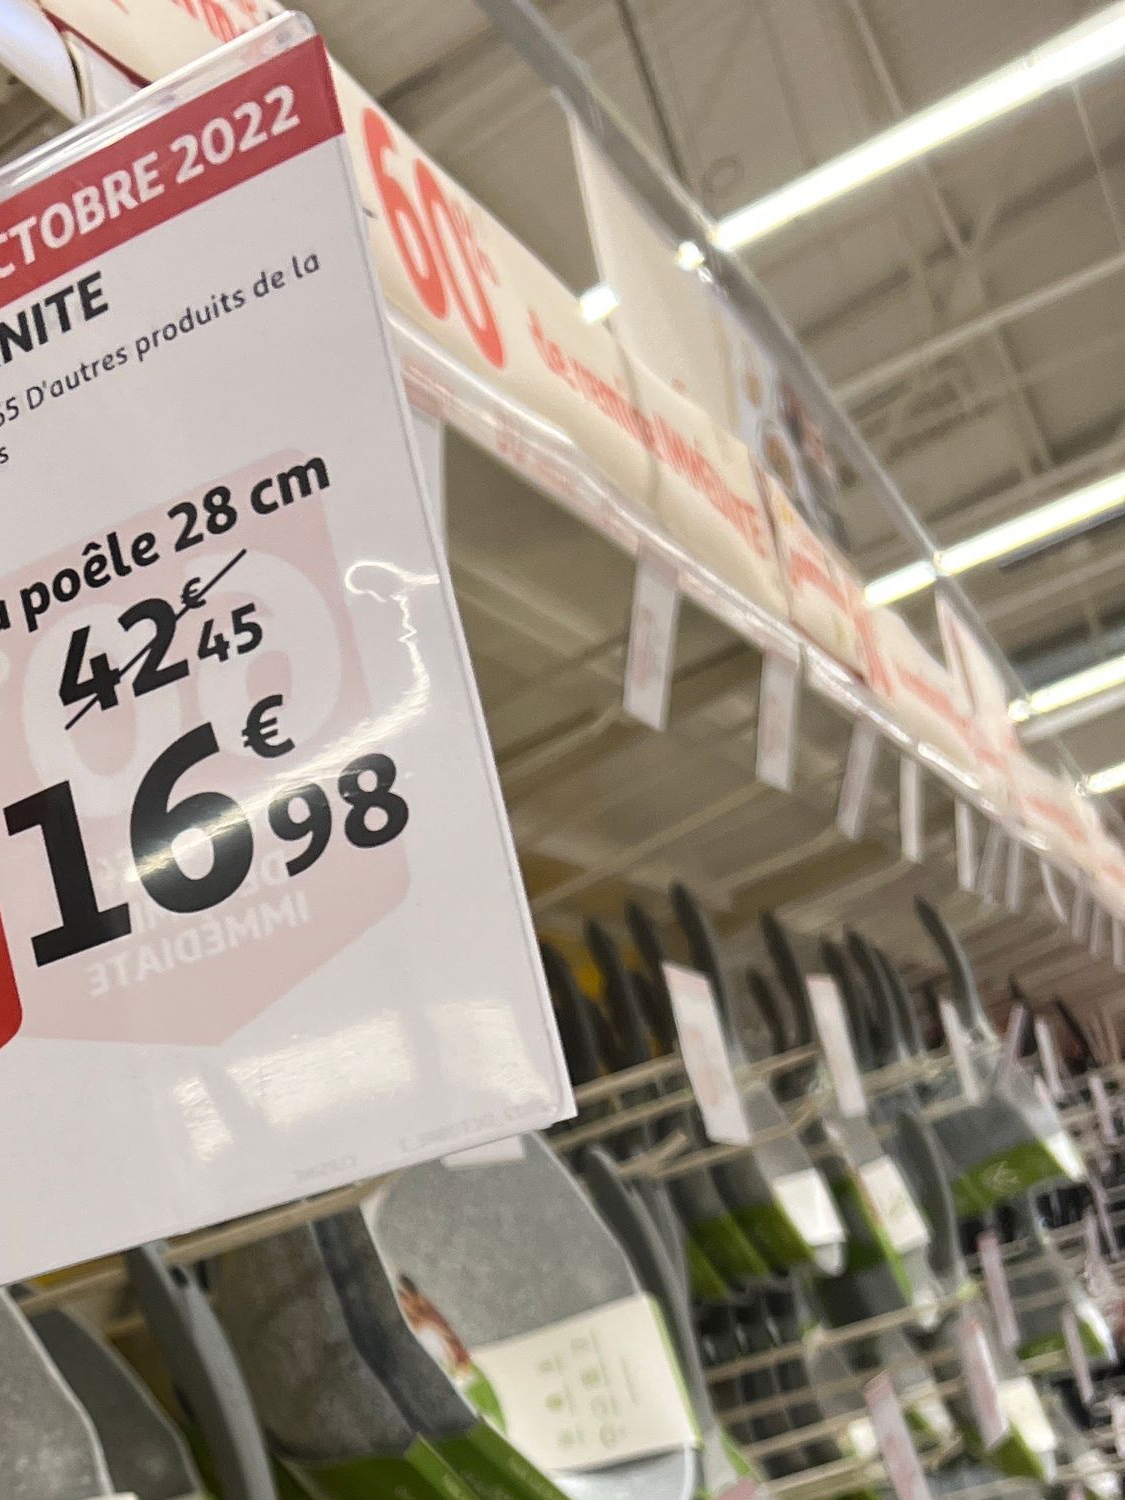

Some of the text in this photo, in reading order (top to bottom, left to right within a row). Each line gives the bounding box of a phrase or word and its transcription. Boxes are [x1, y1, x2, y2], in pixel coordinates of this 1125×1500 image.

[175, 84, 300, 183] 2022
[27, 344, 128, 410] D'autres
[135, 287, 247, 362] produits
[252, 268, 286, 298] de
[291, 251, 321, 278] la
[20, 530, 162, 633] poêle
[168, 486, 239, 554] 28
[250, 456, 331, 517] cm
